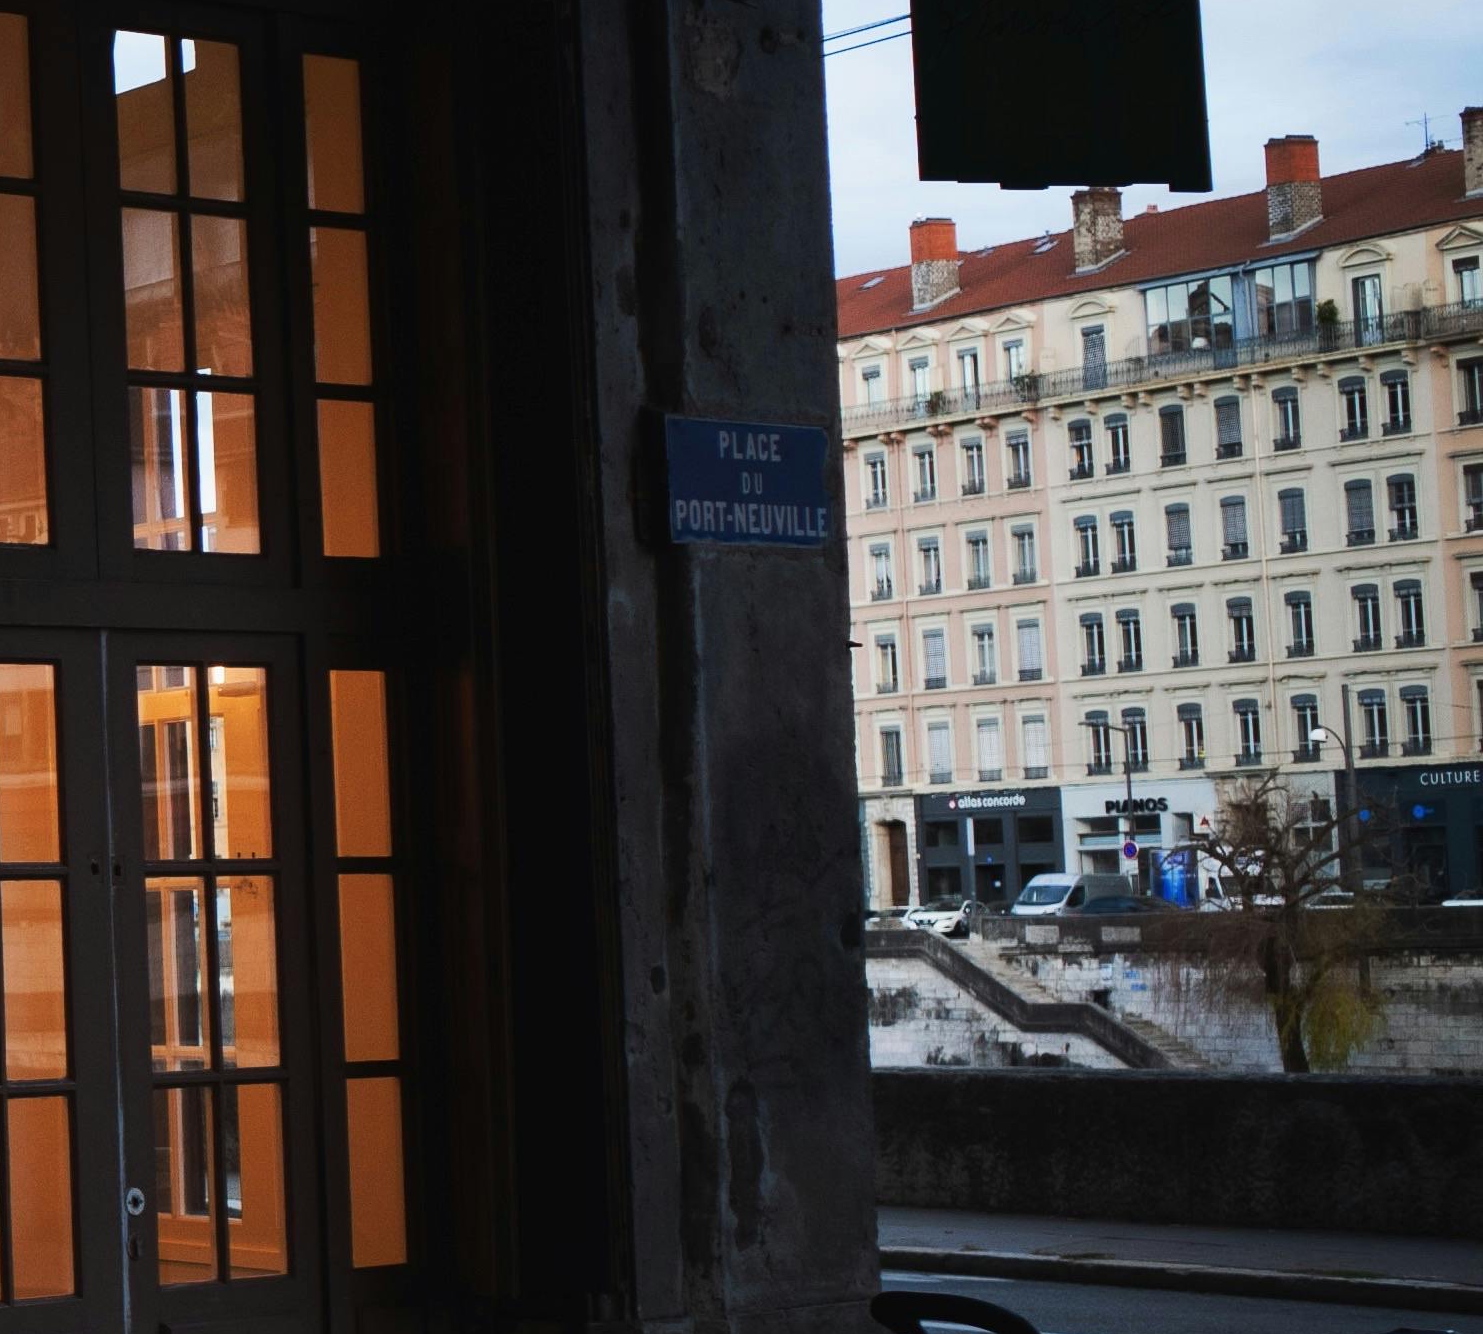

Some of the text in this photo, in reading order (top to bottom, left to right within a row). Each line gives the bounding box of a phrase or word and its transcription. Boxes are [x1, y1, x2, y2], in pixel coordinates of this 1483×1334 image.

[719, 431, 782, 462] PLACE
[741, 472, 763, 495] DU
[676, 499, 828, 537] PORT-NEUVILLE
[1420, 770, 1481, 785] CULTURE
[958, 794, 1026, 809] atlas concorde
